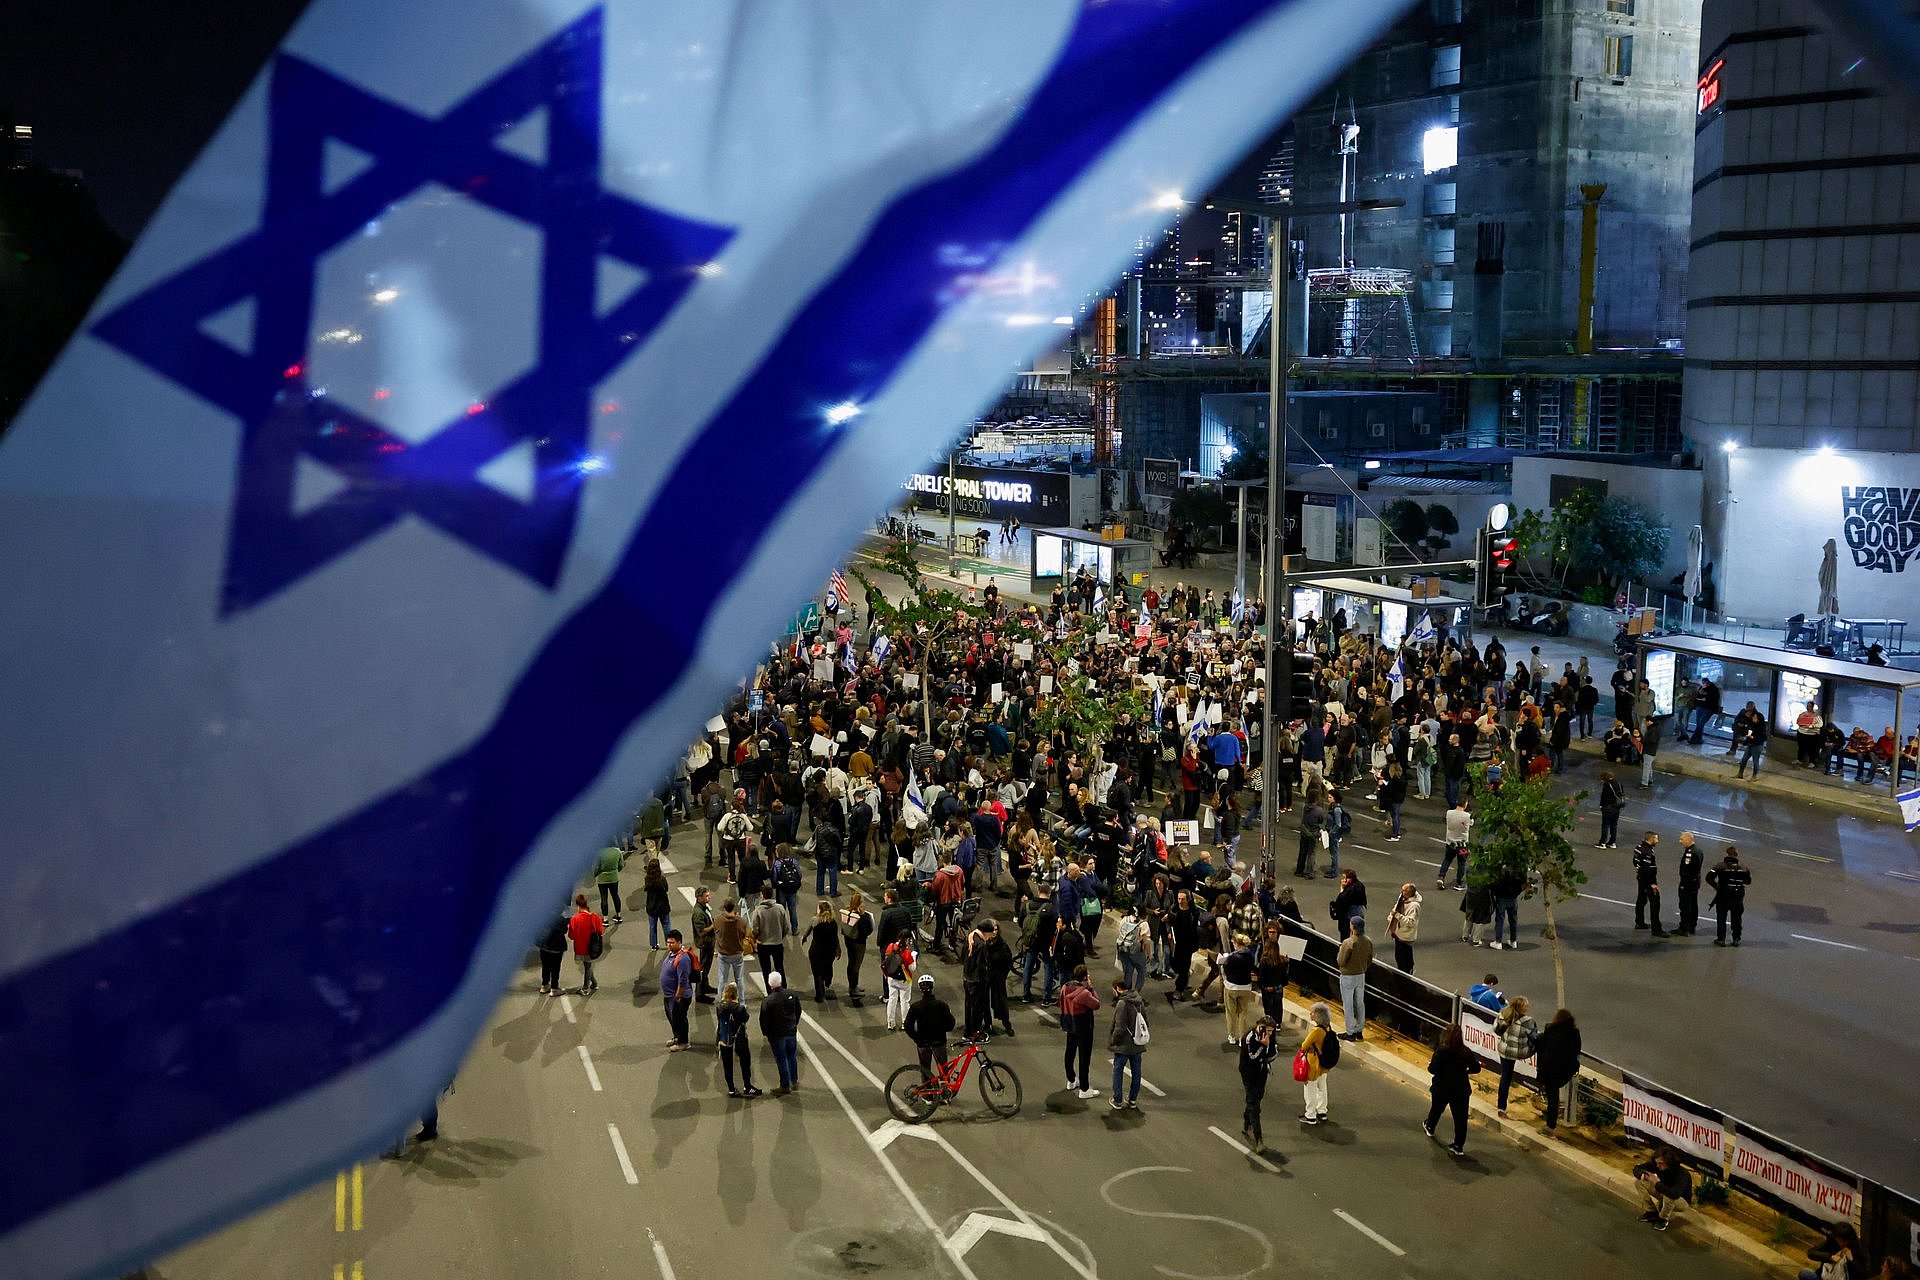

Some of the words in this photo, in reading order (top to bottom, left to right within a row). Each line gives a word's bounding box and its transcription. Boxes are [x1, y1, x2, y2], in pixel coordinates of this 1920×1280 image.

[983, 480, 1032, 503] TOWER
[968, 499, 991, 515] SOON
[1844, 517, 1920, 551] GOOD
[1851, 545, 1915, 573] DAY
[1623, 1097, 1663, 1128] מהגיהנום
[1665, 1113, 1689, 1139] אותם
[1692, 1122, 1720, 1151] תוציאו
[1737, 1148, 1782, 1186] מהגיהנום
[1785, 1169, 1812, 1199] אותם
[1815, 1182, 1852, 1217] תוציאו
